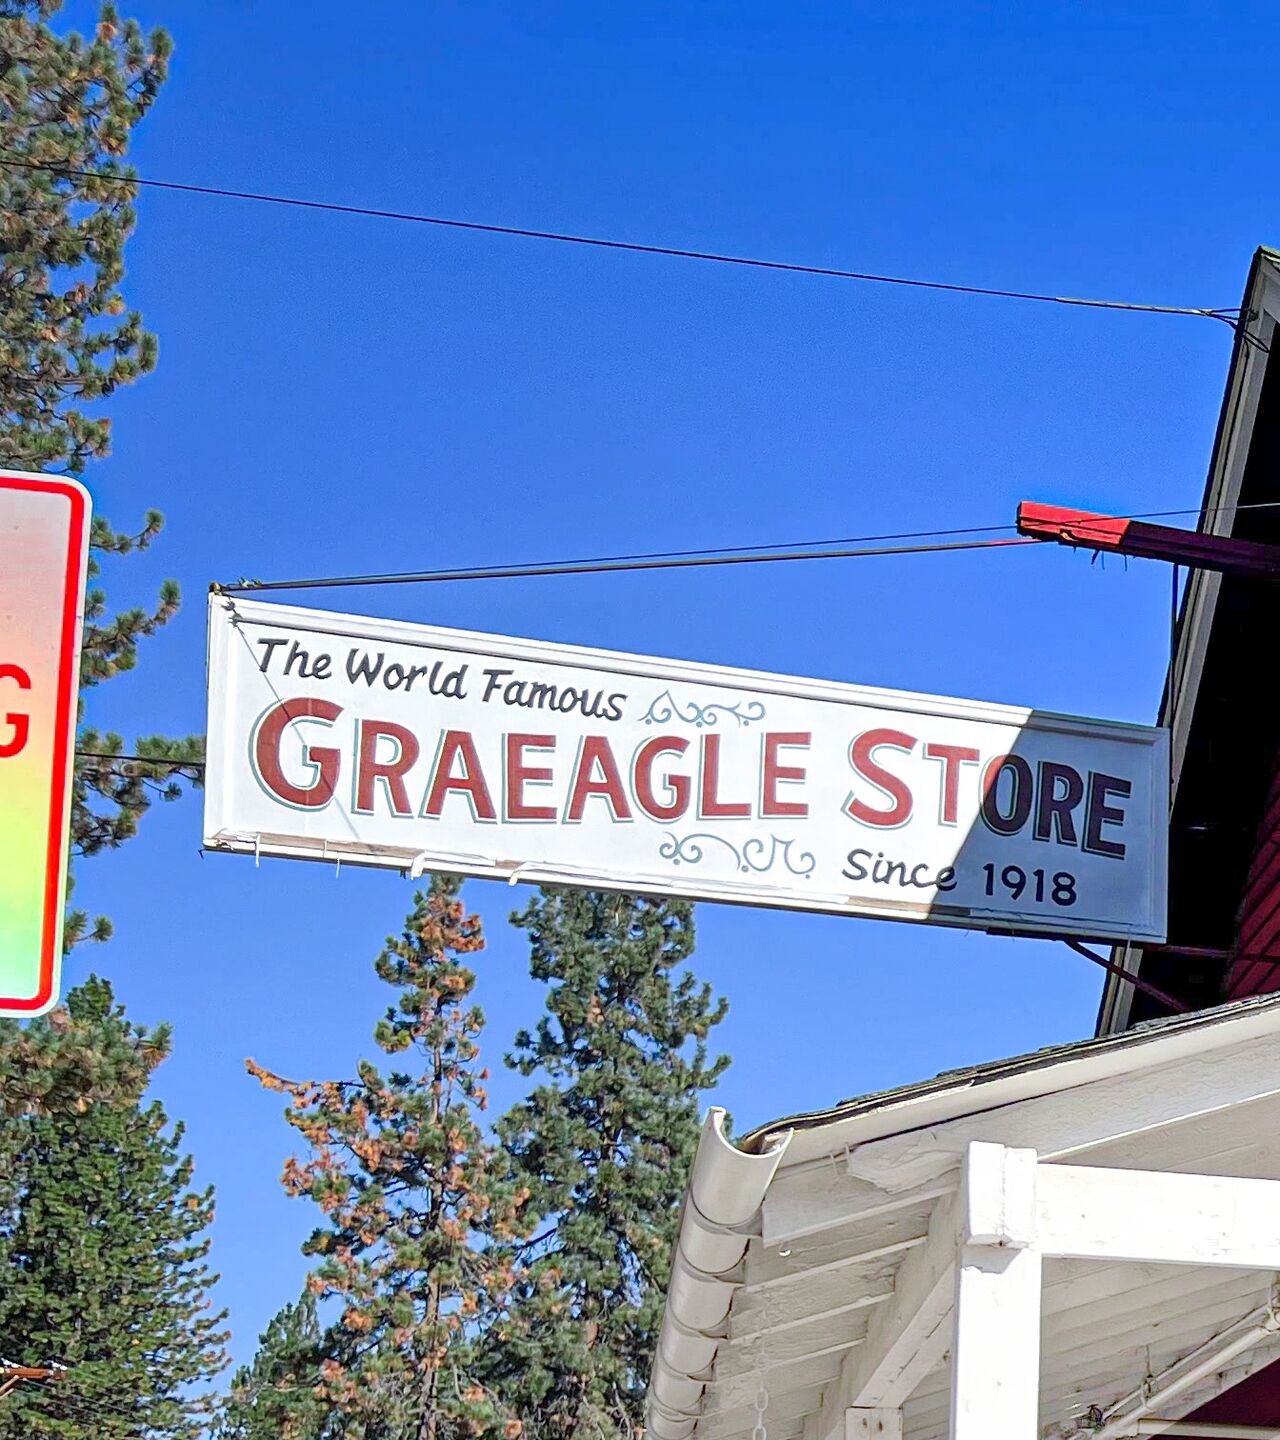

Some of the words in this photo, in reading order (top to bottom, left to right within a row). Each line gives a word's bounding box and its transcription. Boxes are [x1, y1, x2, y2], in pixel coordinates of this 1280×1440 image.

[256, 638, 332, 680] The
[346, 648, 468, 701] World
[481, 668, 629, 722] Famous
[250, 696, 812, 824] GRAEAGLE
[841, 727, 1132, 860] STORE
[842, 848, 957, 892] Since
[982, 863, 1078, 907] 1918
